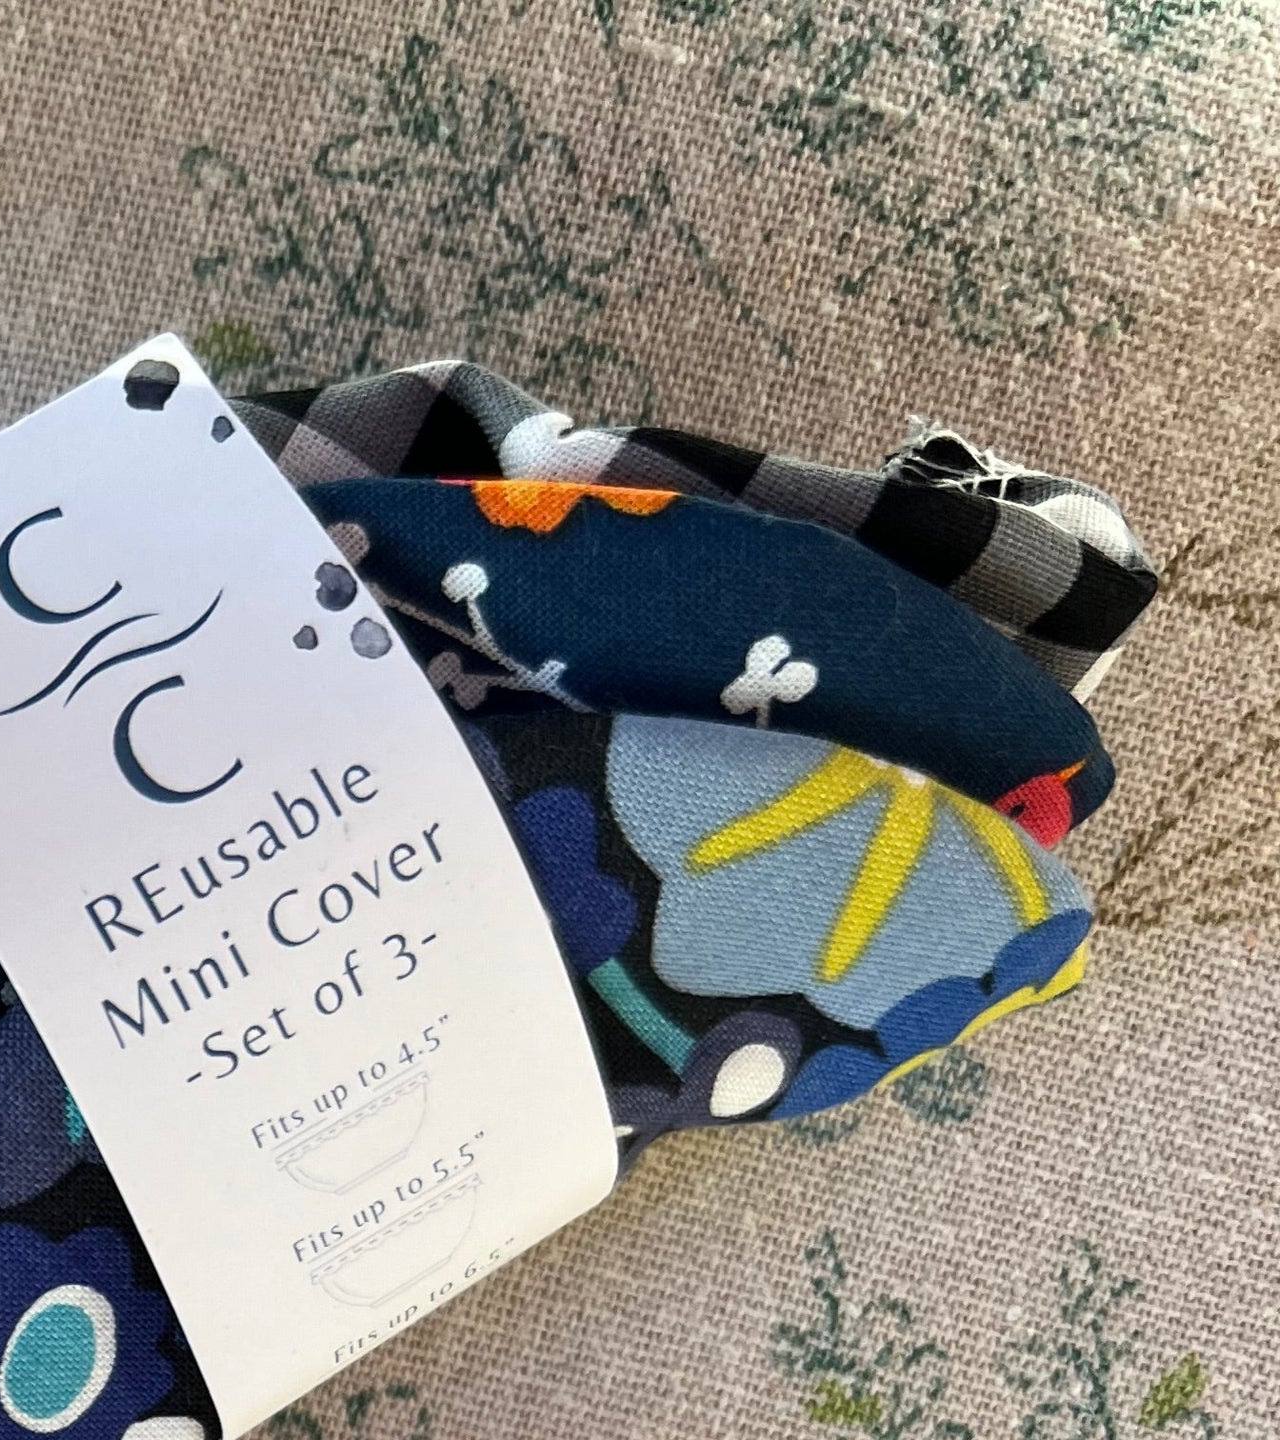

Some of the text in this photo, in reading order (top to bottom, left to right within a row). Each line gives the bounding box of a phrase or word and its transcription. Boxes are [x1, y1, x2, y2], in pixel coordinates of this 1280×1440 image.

[114, 675, 243, 803] C
[85, 762, 378, 952] REusable
[102, 822, 443, 1050] Mini Cover
[186, 929, 437, 1087] -Set of 3-
[251, 1110, 304, 1148] Fits
[313, 1084, 348, 1113] up
[357, 1061, 386, 1087] to
[292, 1225, 344, 1262] Fits
[353, 1199, 386, 1228] up
[395, 1176, 423, 1202] to
[334, 1329, 378, 1364] Fits
[389, 1303, 418, 1329] up
[428, 1281, 454, 1302] to
